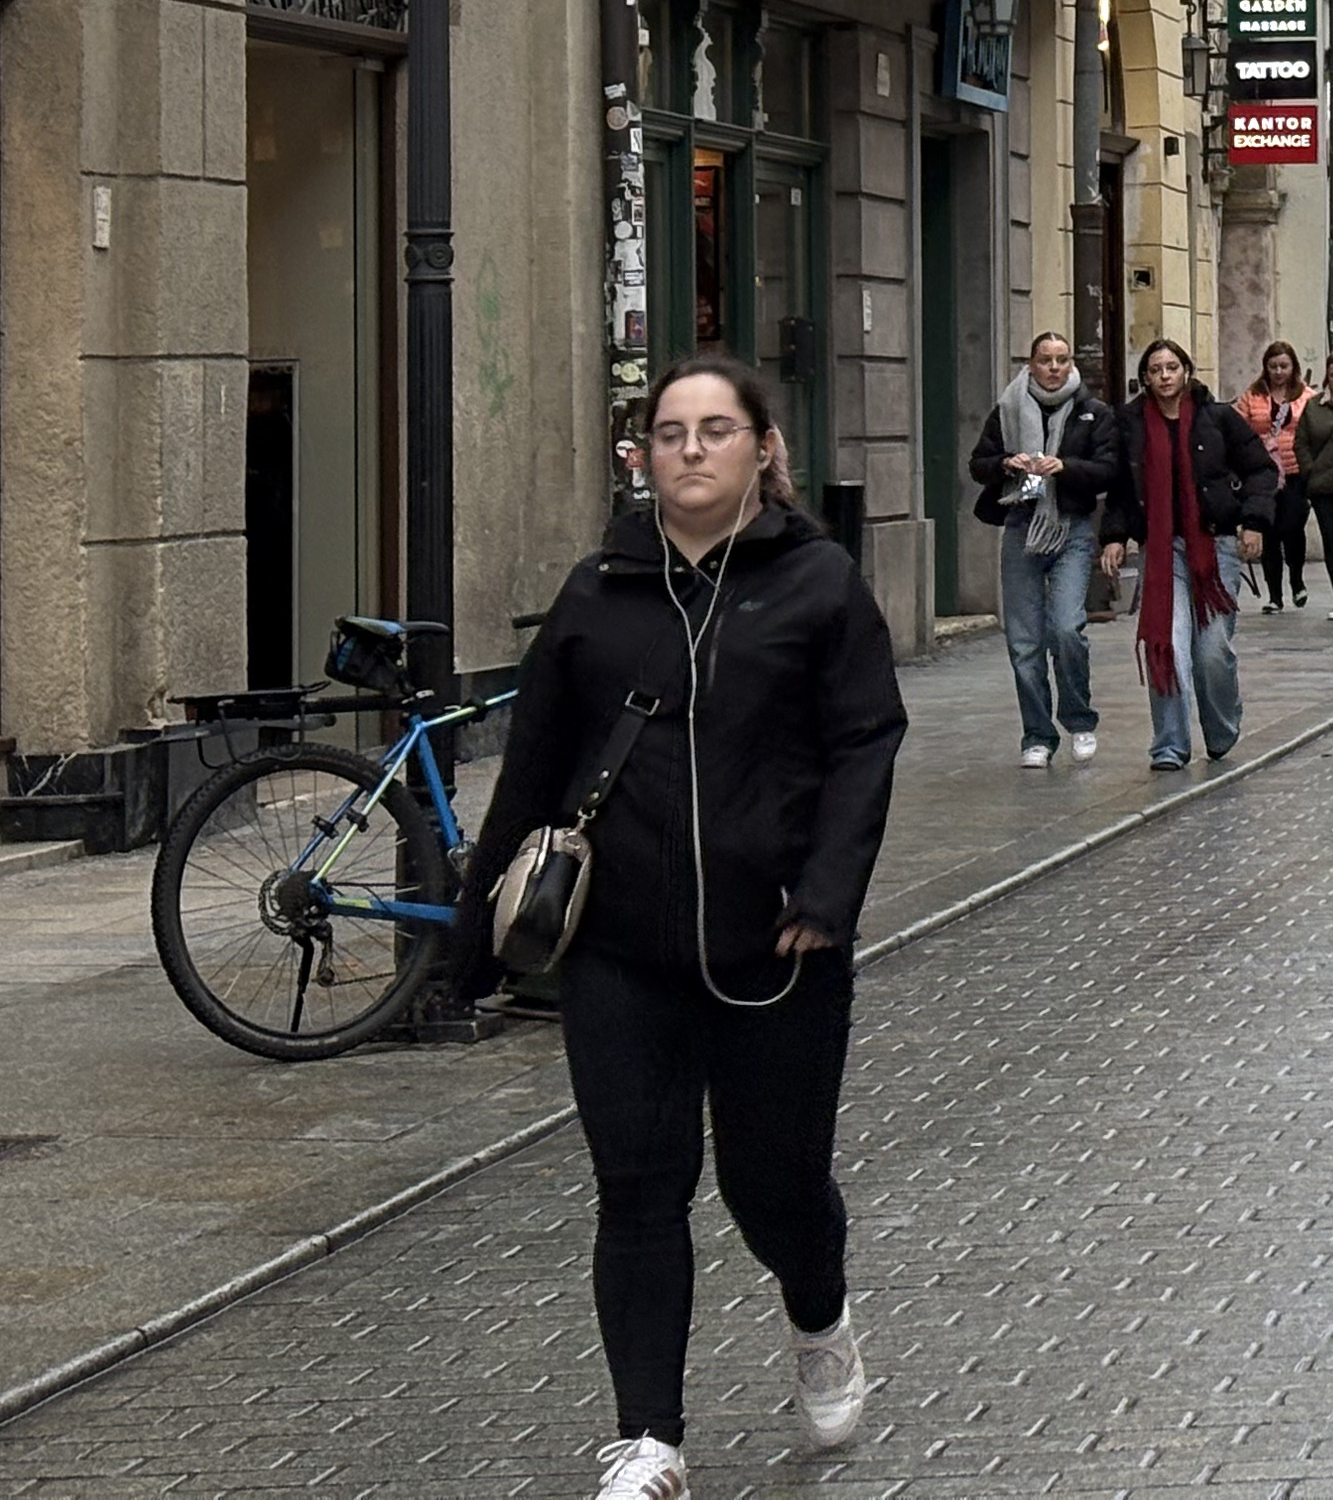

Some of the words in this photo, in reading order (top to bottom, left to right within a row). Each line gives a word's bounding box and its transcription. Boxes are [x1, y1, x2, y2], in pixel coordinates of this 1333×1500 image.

[1239, 0, 1307, 13] GARDEN
[1235, 60, 1310, 79] TATTOO
[1233, 117, 1312, 131] KANTOR
[1233, 134, 1311, 148] EXCHANGE
